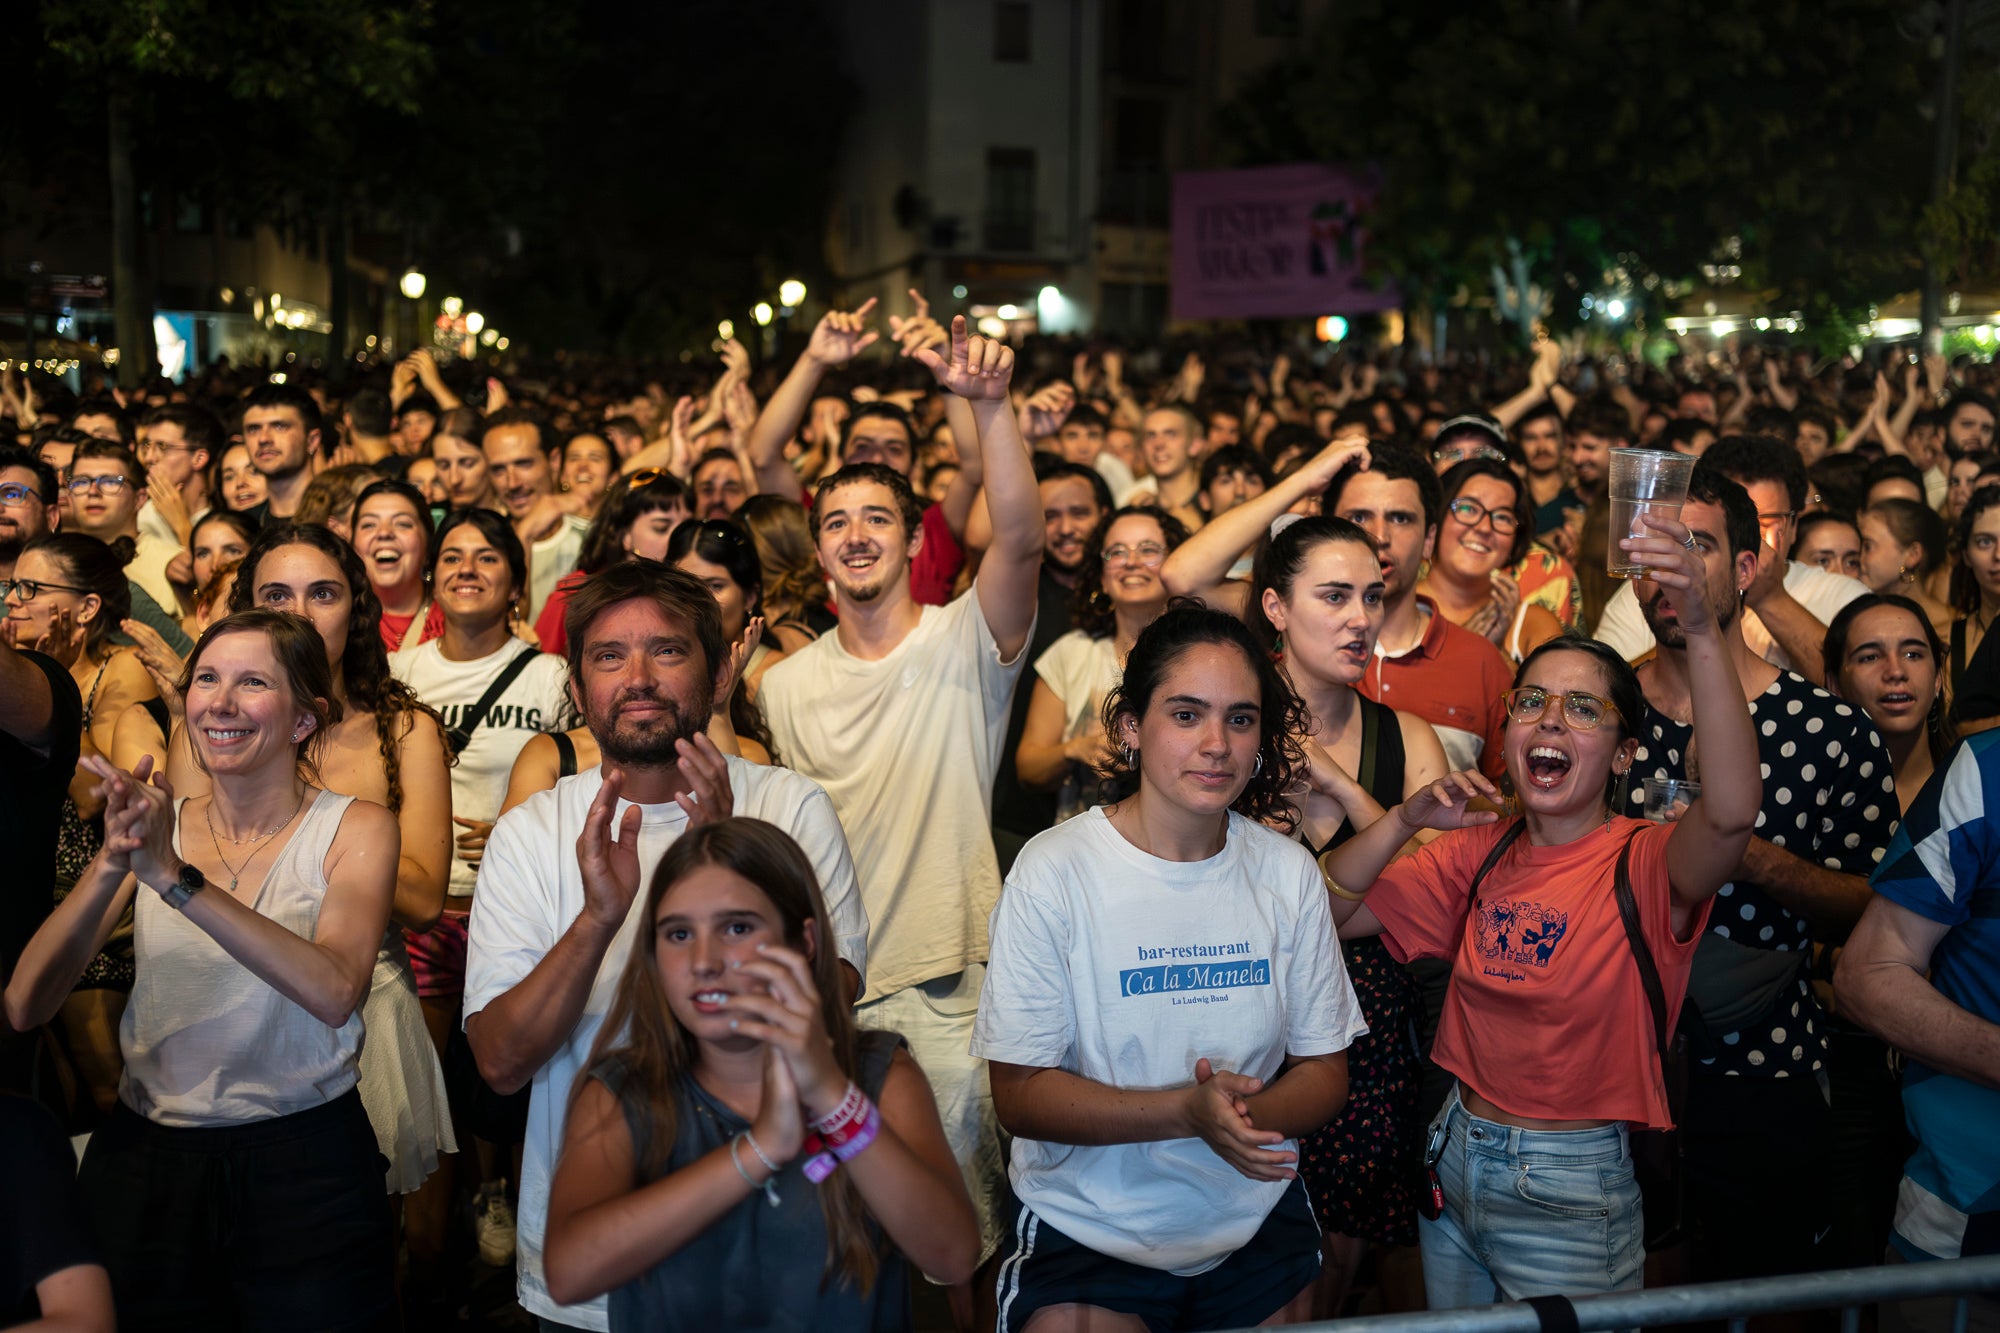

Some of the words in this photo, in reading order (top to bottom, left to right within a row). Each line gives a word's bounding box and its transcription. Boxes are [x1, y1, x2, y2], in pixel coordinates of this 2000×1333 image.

[1138, 940, 1250, 961] bar-restaurant
[1126, 971, 1156, 997] Ca
[1163, 964, 1181, 990] la
[1187, 959, 1265, 989] Manela
[1172, 997, 1182, 1005] La
[1183, 996, 1210, 1005] Ludwig
[1211, 994, 1229, 1003] Band
